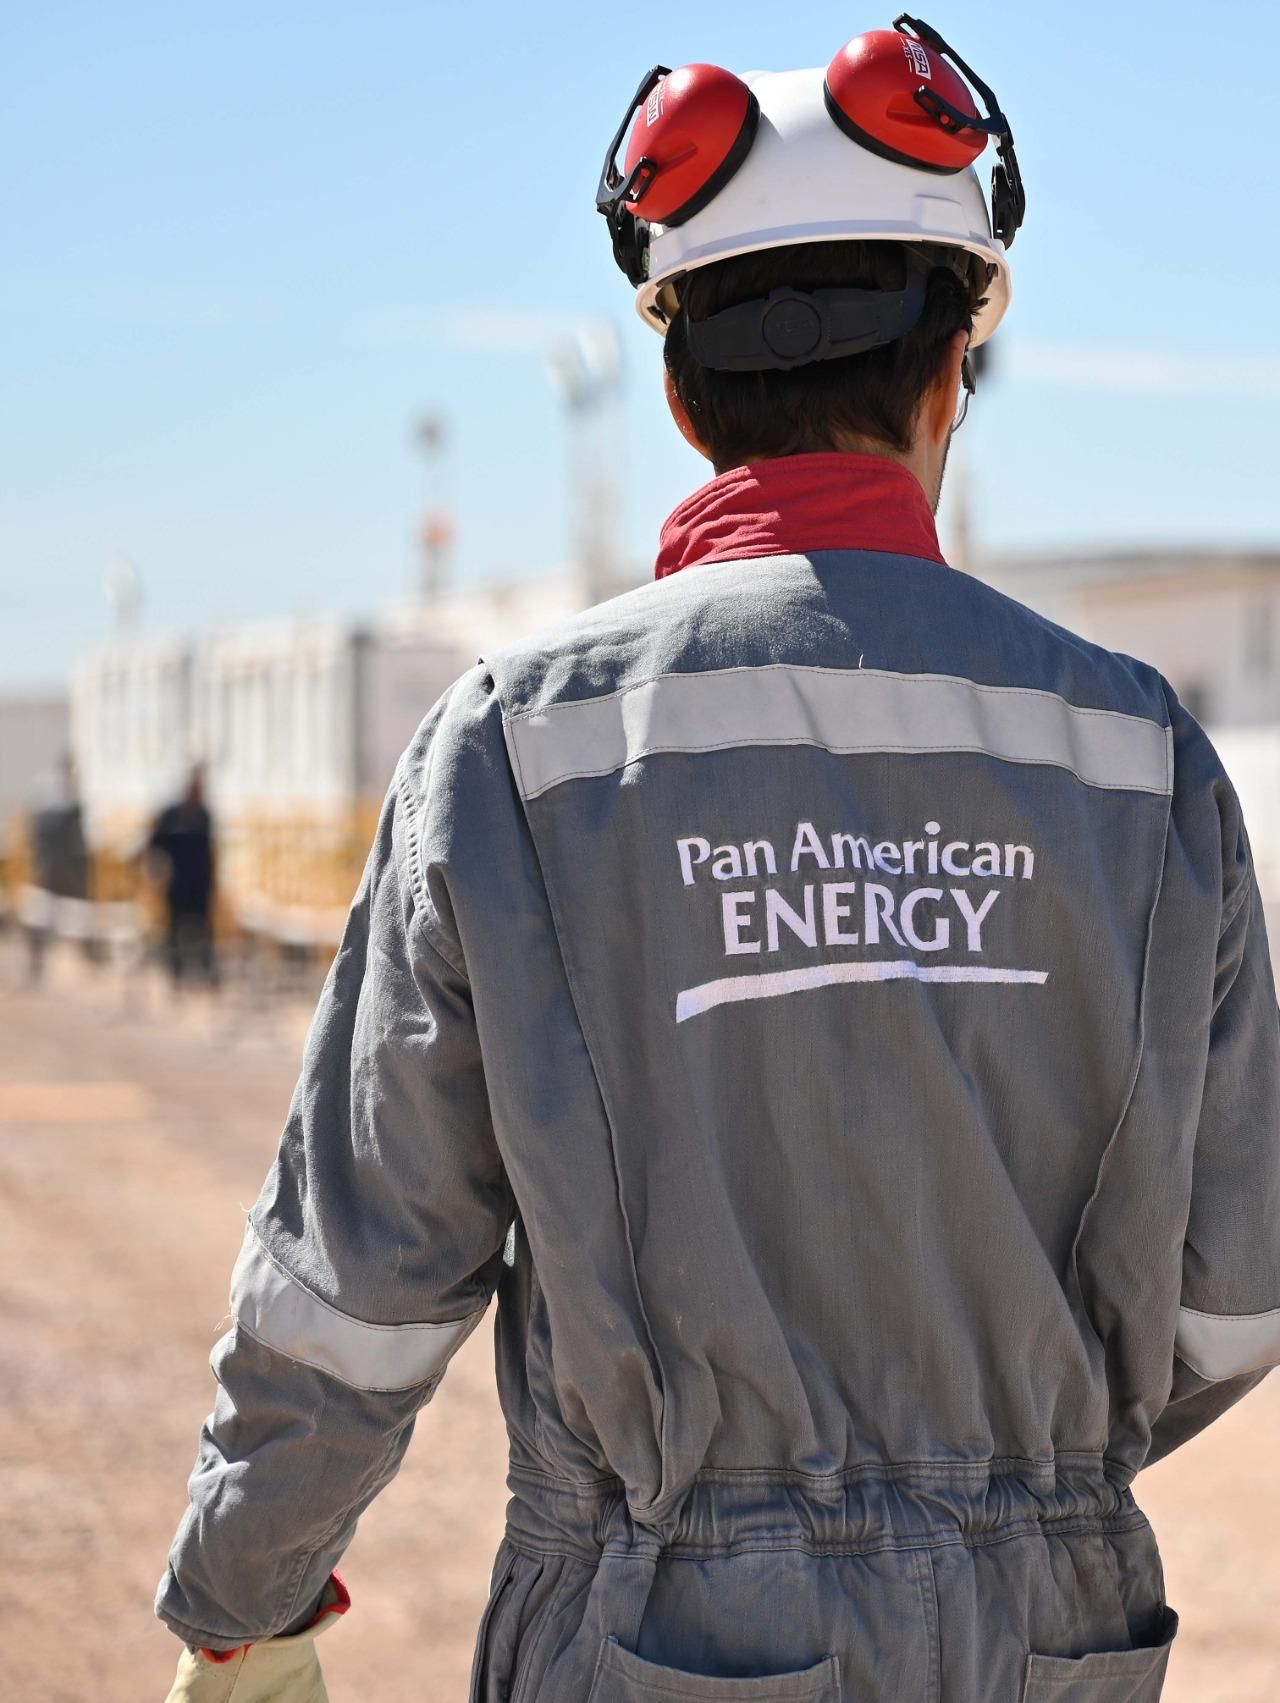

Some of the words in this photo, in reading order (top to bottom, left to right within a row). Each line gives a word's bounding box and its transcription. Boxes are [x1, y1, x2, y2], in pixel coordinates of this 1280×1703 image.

[676, 837, 777, 886] Pan
[790, 820, 1035, 880] American
[721, 881, 1001, 955] ENERGY
